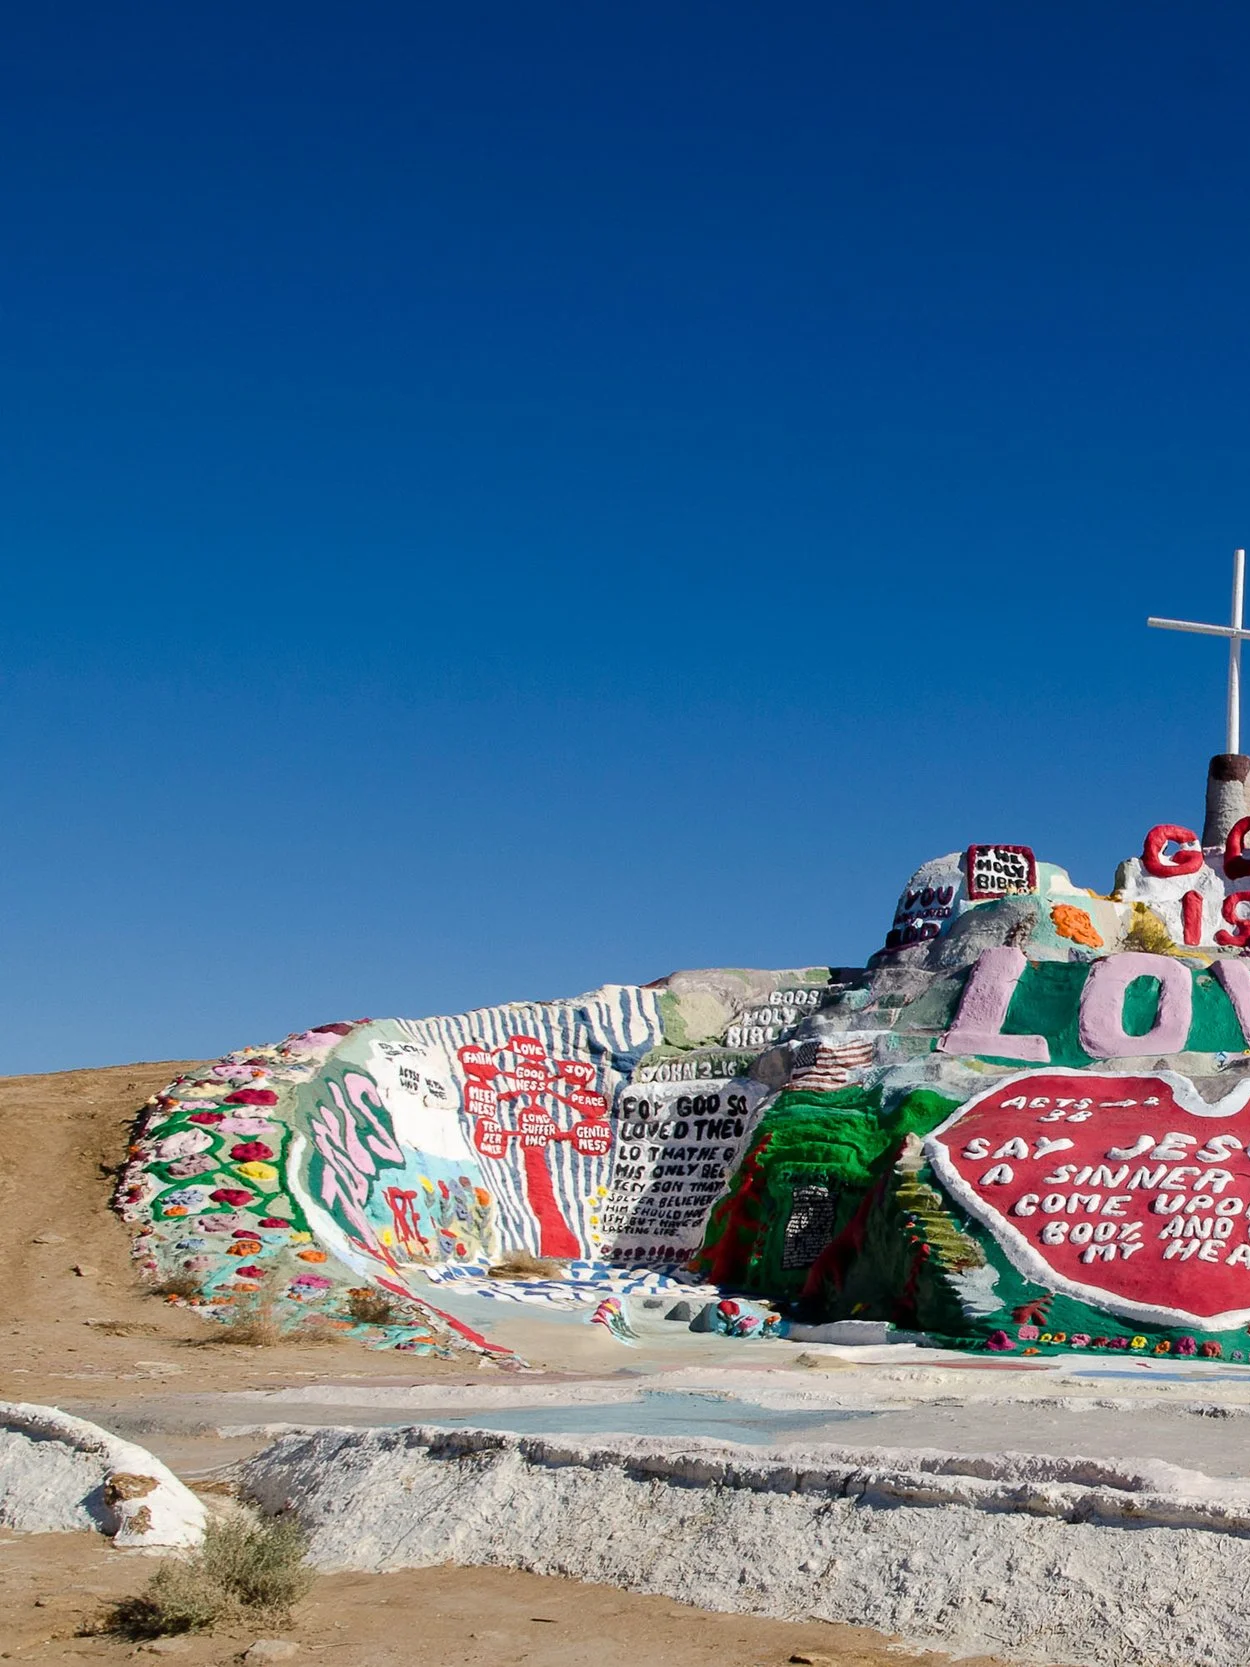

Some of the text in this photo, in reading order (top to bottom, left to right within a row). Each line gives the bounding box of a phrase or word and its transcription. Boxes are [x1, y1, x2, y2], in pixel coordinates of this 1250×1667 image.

[977, 859, 1024, 878] HOLY
[904, 886, 954, 910] YOU
[742, 1006, 797, 1027] HOLY
[727, 1026, 790, 1048] BIBL
[512, 1041, 544, 1056] LOVE
[463, 1052, 492, 1066] FAITH
[516, 1066, 545, 1081] GOOD
[564, 1064, 594, 1083] JOY
[640, 1062, 697, 1082] JOHN
[516, 1080, 546, 1091] NESS
[571, 1094, 605, 1107] PEACE
[677, 1094, 720, 1118] GOD
[728, 1095, 748, 1117] SO
[1000, 1096, 1093, 1110] ACTS
[469, 1101, 495, 1117] NESS
[522, 1114, 550, 1124] LONG
[483, 1133, 502, 1144] PER
[520, 1124, 555, 1137] SUFFER
[576, 1126, 610, 1139] GENTLE
[621, 1120, 689, 1141] LOVED
[525, 1136, 547, 1147] ING
[579, 1139, 607, 1153] NESS
[962, 1136, 1075, 1160] SAY
[616, 1163, 645, 1180] HIS
[652, 1164, 699, 1178] ONLY
[979, 1163, 1014, 1186] A
[1043, 1163, 1235, 1194] SINNER
[651, 1181, 684, 1193] SON
[605, 1204, 628, 1213] HIM
[631, 1206, 681, 1220] SHOULD
[1014, 1192, 1132, 1217] COME
[629, 1216, 656, 1226] BUT
[1158, 1215, 1234, 1239] AND
[602, 1225, 649, 1235] LASTING
[1081, 1241, 1144, 1264] MY
